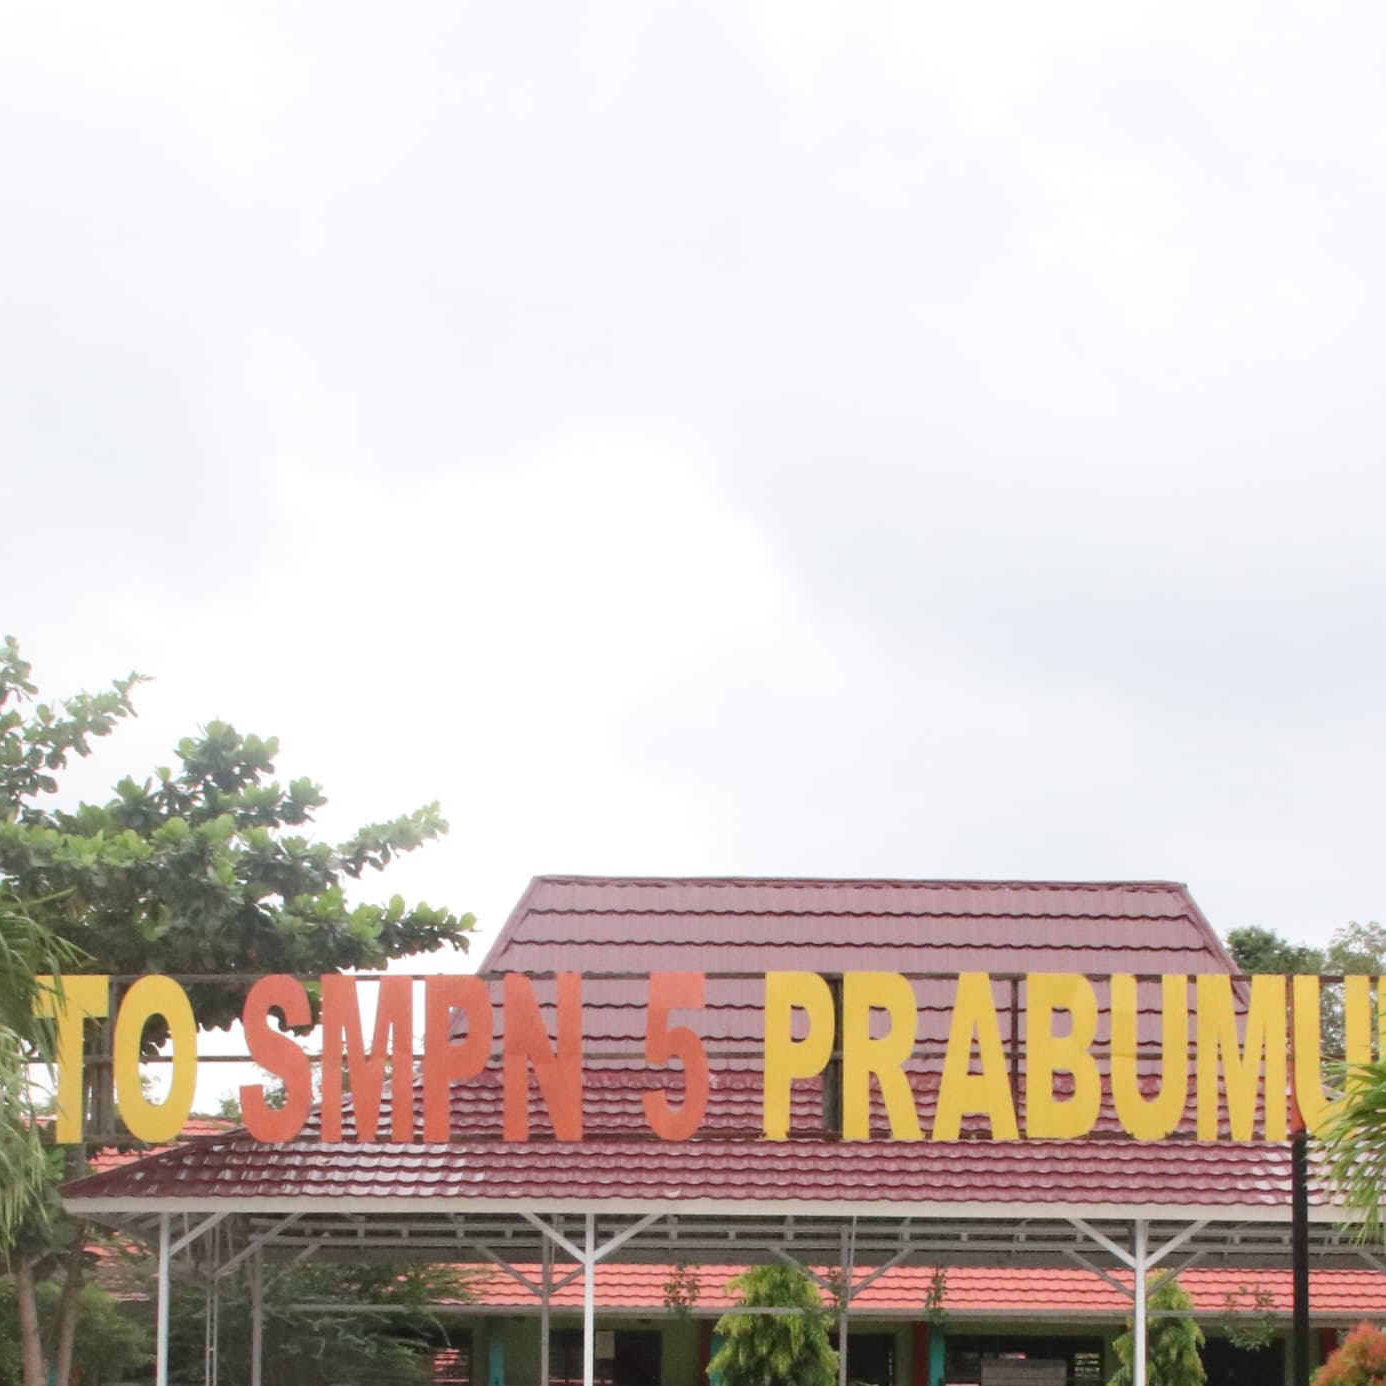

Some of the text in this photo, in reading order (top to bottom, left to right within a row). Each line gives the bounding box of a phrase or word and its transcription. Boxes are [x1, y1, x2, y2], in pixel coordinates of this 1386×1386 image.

[34, 973, 199, 1145] TO
[239, 972, 584, 1144] SMPN
[641, 972, 708, 1143] 5
